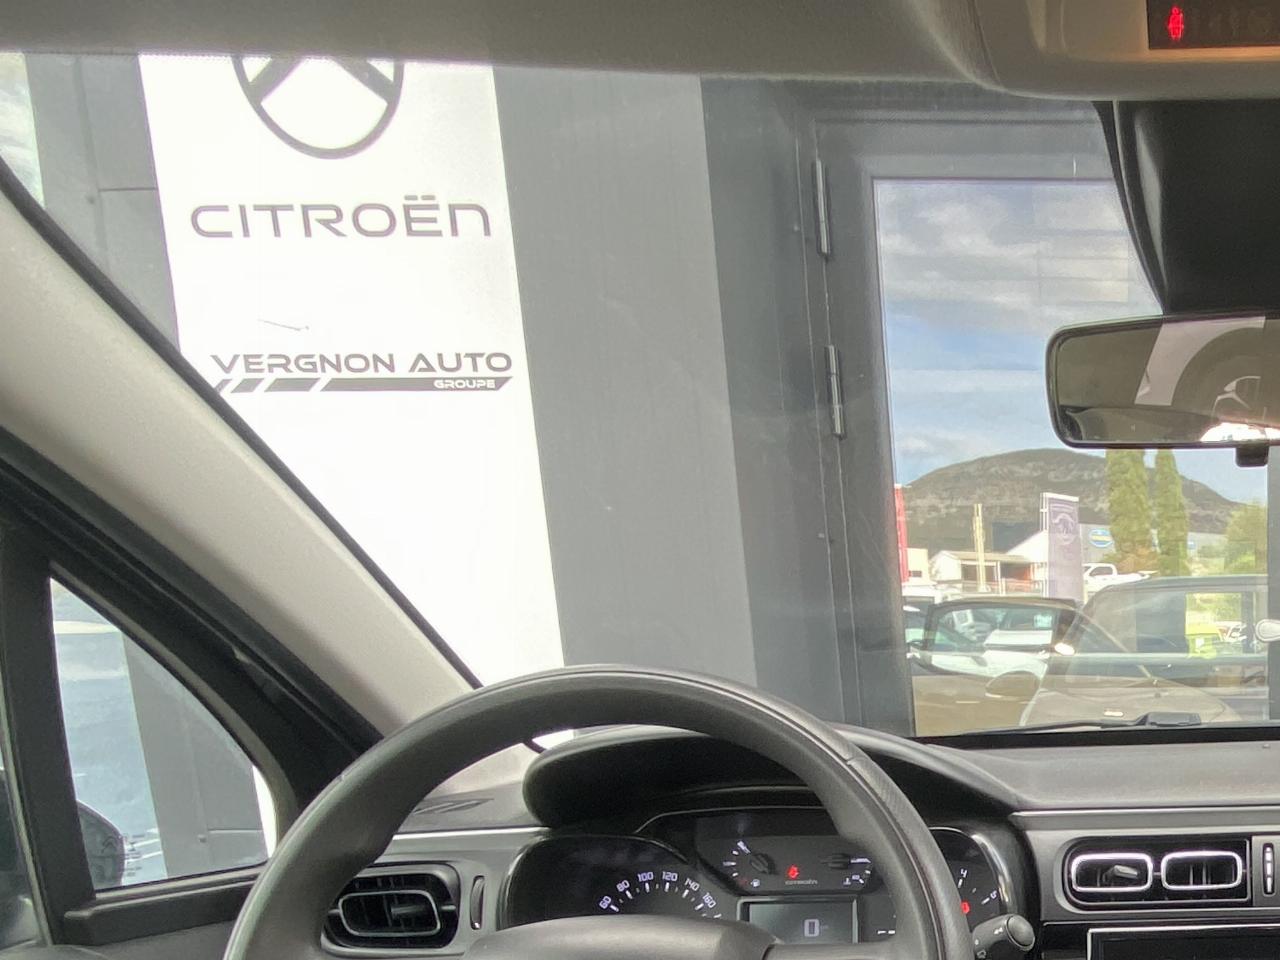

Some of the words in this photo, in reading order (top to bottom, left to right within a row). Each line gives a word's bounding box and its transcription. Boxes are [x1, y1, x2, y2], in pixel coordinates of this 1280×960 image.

[210, 353, 395, 374] VERGNON
[409, 351, 513, 373] AUTO
[433, 378, 496, 390] GROUPE
[637, 871, 654, 883] 100
[662, 871, 678, 882] 120
